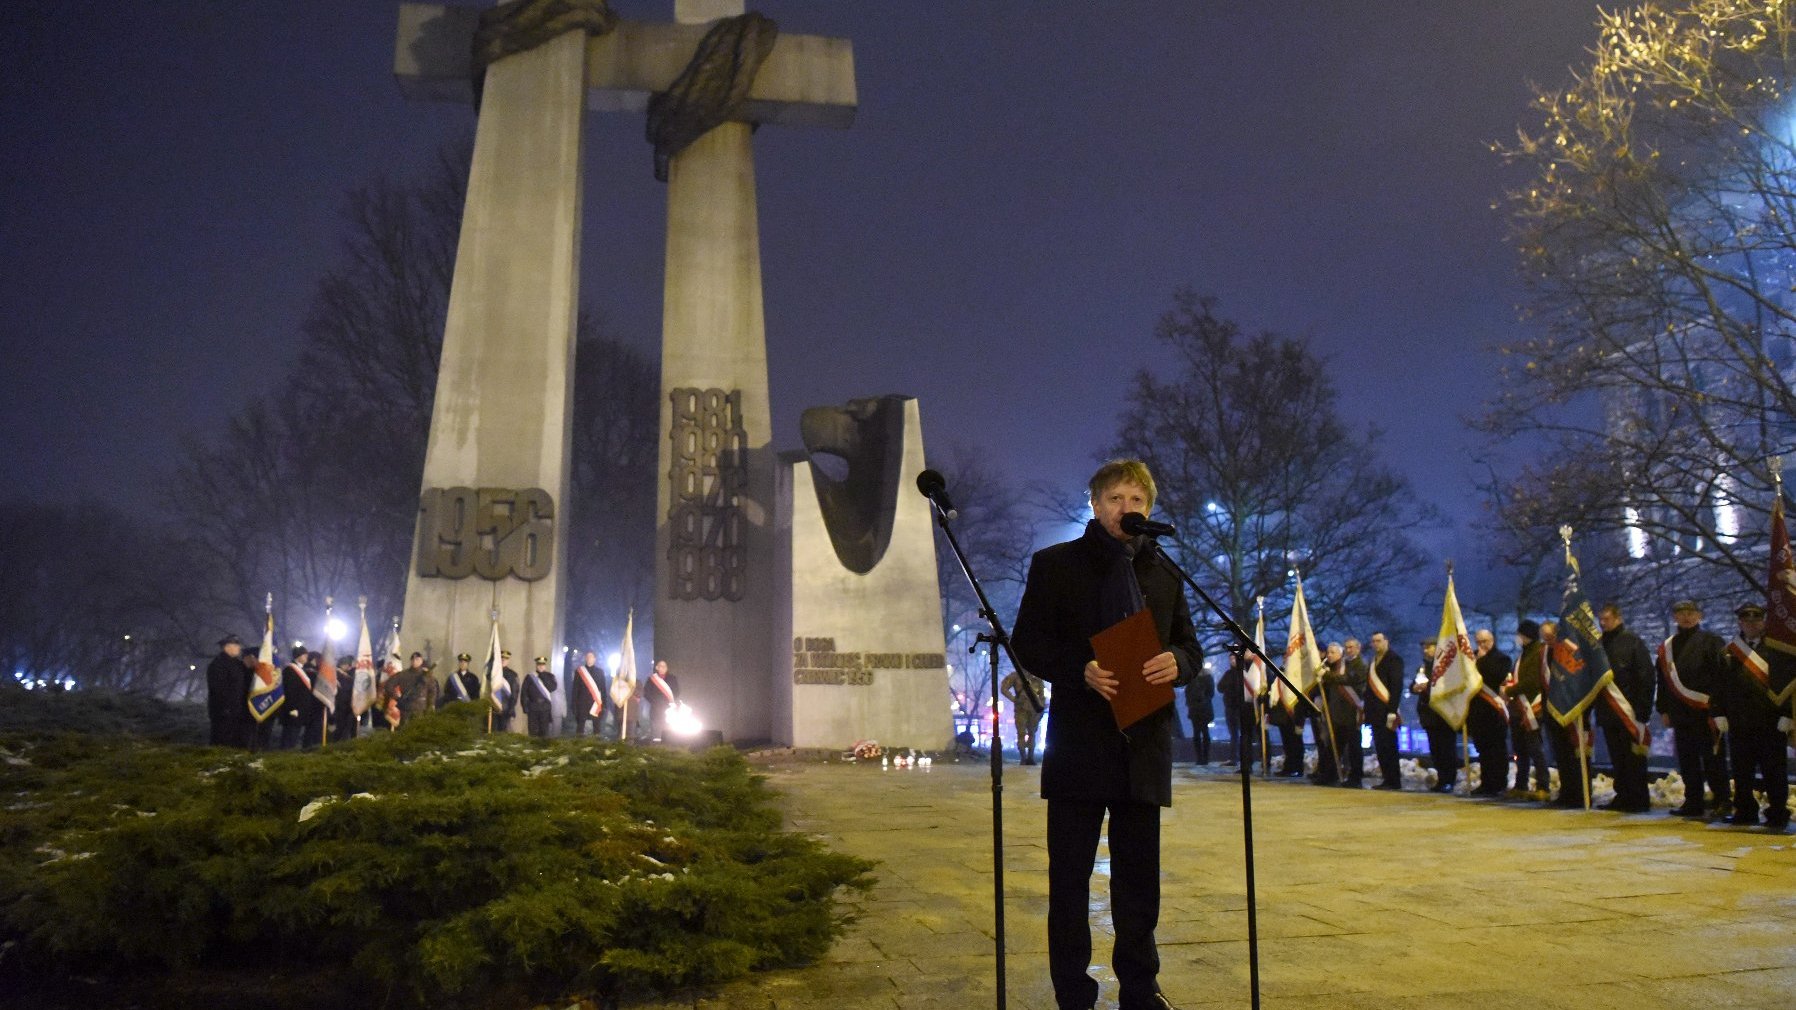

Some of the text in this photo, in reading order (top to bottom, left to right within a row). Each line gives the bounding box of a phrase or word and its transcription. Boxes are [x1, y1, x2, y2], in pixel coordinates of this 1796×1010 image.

[670, 388, 743, 430] 1981
[669, 428, 748, 469] 1980
[417, 486, 555, 581] 1956
[668, 507, 748, 547] 1970
[667, 546, 747, 601] 1968
